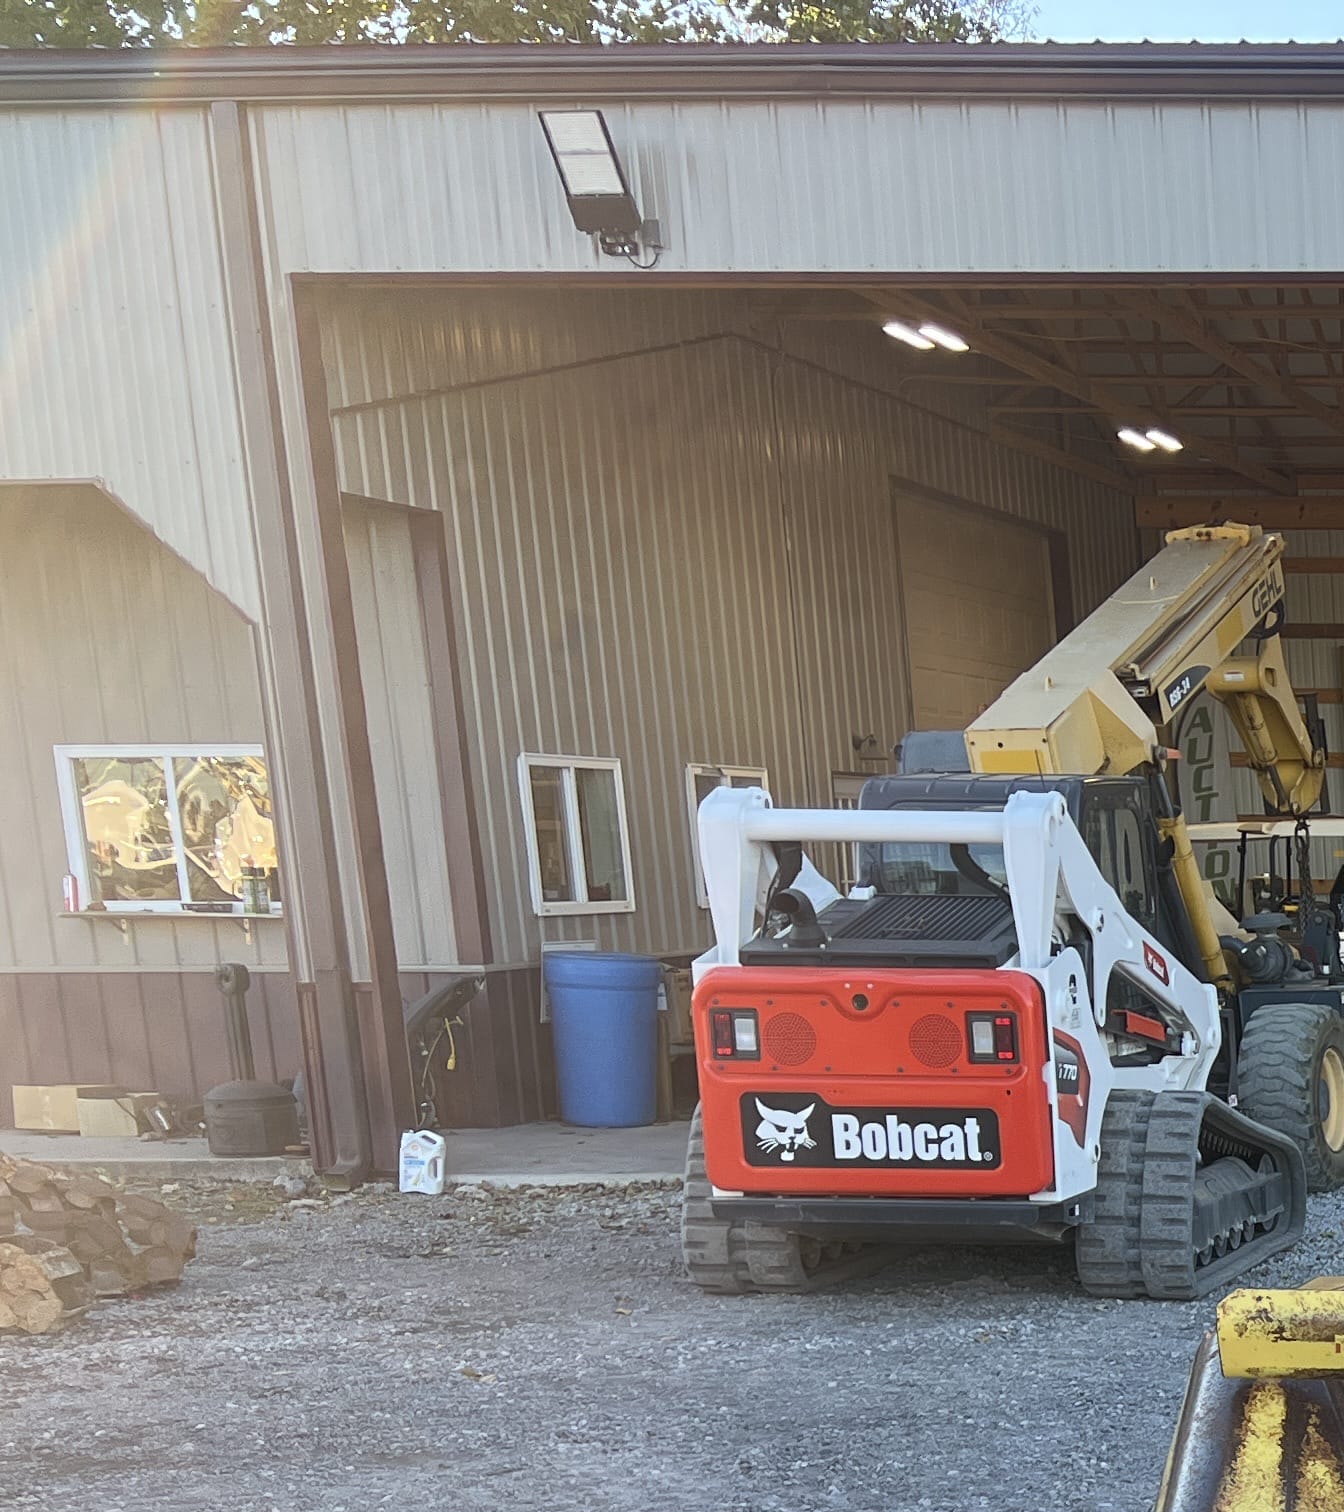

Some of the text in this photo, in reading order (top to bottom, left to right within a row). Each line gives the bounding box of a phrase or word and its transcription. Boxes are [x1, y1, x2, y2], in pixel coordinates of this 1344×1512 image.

[1252, 571, 1282, 618] GEHL
[1184, 706, 1239, 907] AUCTON
[831, 1112, 983, 1162] Bobcat
